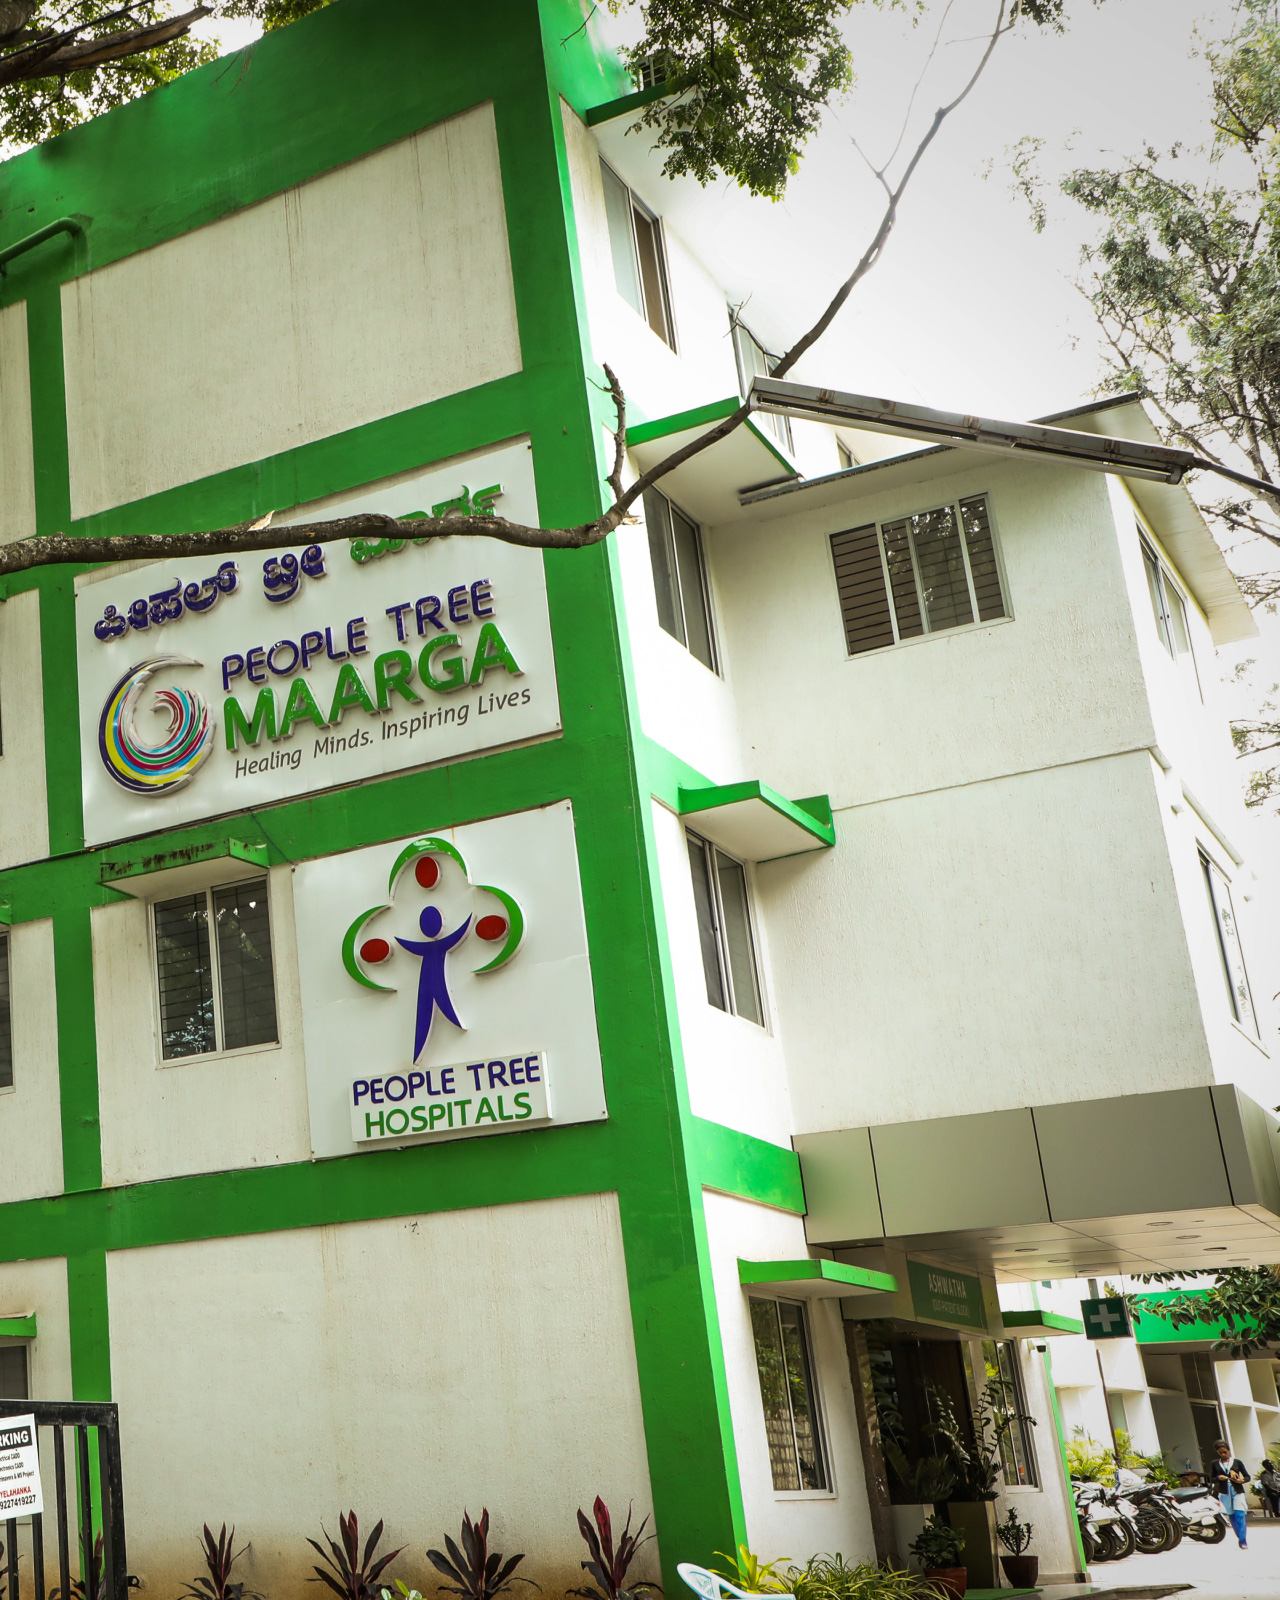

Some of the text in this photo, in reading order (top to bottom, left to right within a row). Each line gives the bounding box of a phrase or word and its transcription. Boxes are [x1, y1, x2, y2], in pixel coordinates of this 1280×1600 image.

[94, 561, 239, 642] ಪೀಪಲ್
[222, 579, 496, 692] PEOPLE TREE
[224, 622, 524, 752] MAARGA
[235, 686, 531, 778] Healing Minds. Inspiring Lives
[353, 1055, 541, 1106] PEOPLE TREE
[365, 1092, 532, 1138] HOSPITALS
[928, 1272, 968, 1299] ASHWATHA
[0, 1486, 31, 1499] YELAHANKA
